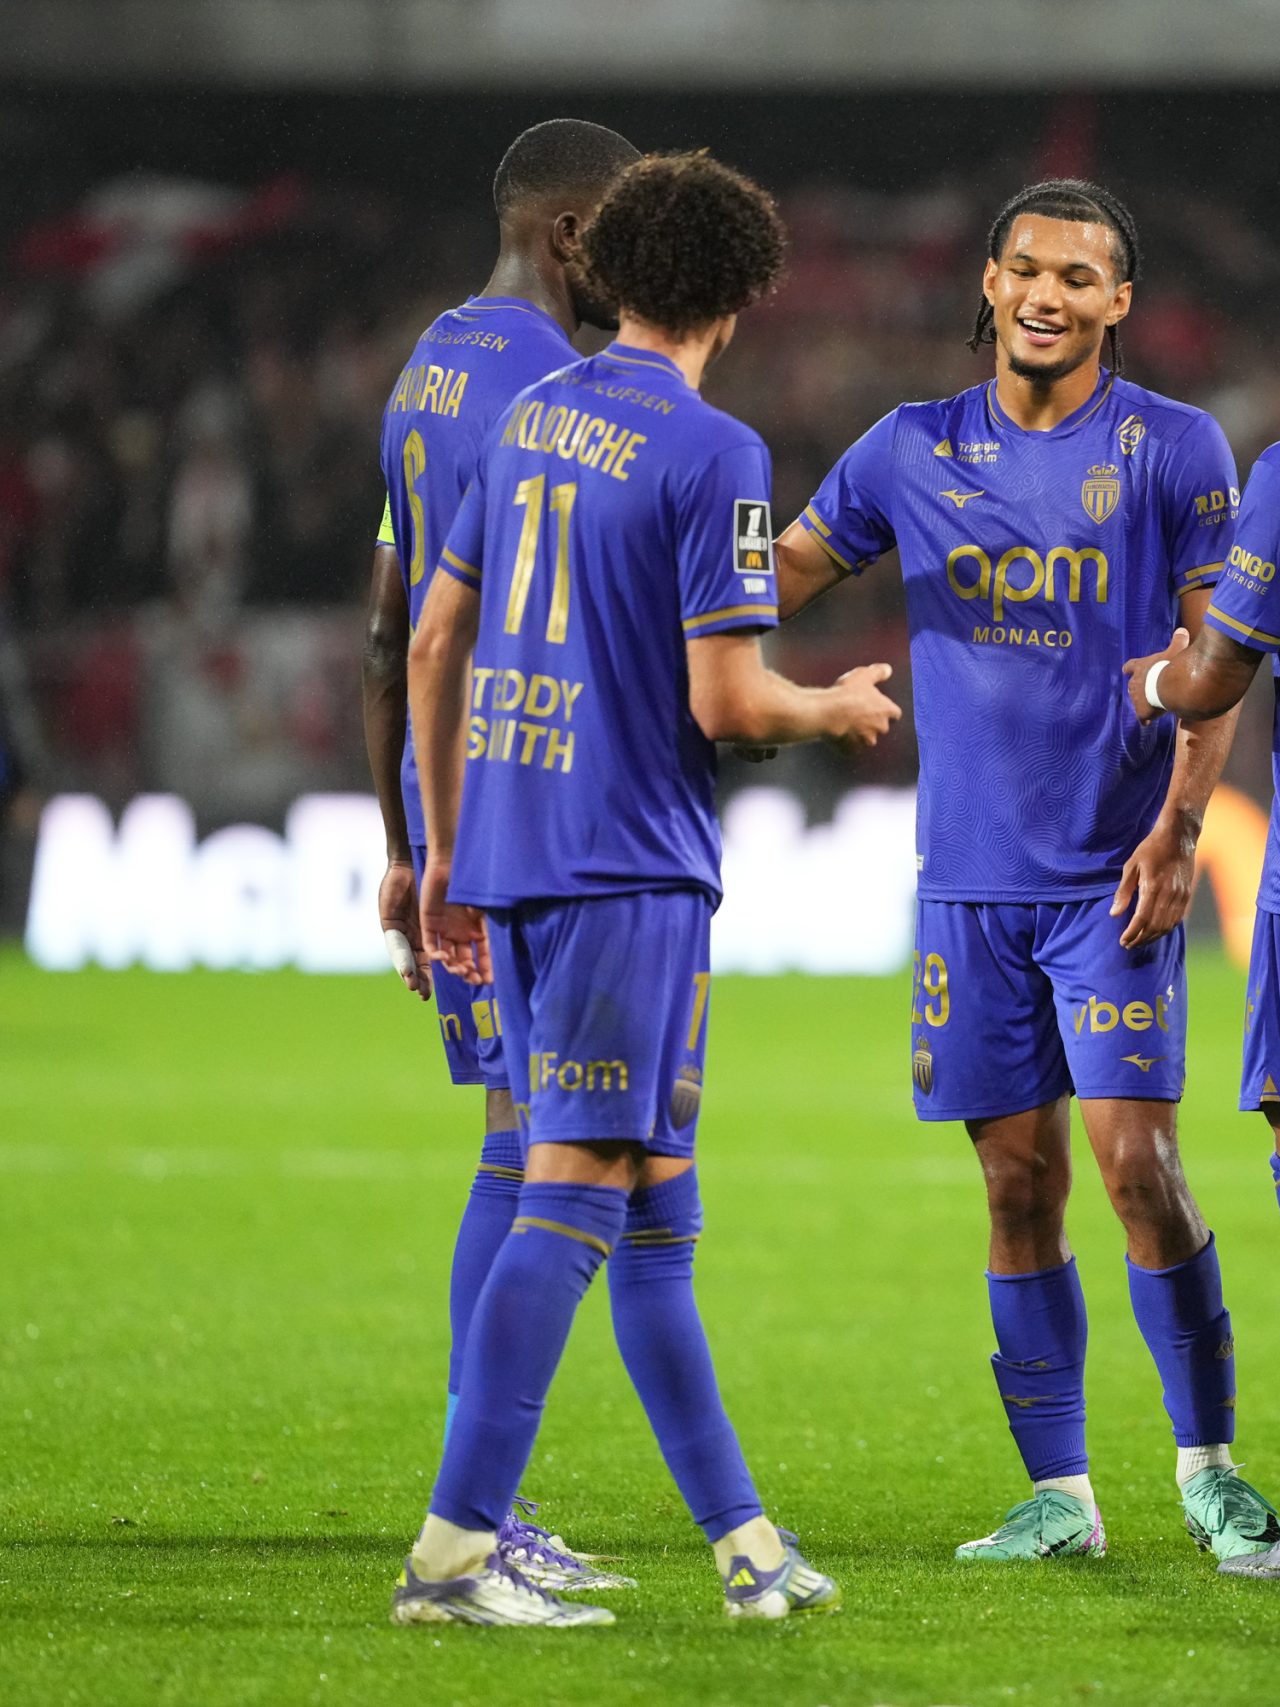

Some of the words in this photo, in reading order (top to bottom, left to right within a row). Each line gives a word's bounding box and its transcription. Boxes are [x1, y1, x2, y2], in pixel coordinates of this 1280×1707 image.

[958, 441, 1000, 455] Triangle
[403, 428, 426, 587] 6
[504, 473, 577, 644] 11
[946, 544, 1108, 622] apm
[1229, 545, 1275, 583] ONGO
[972, 626, 1073, 648] MONACO
[473, 668, 584, 722] TEDDY
